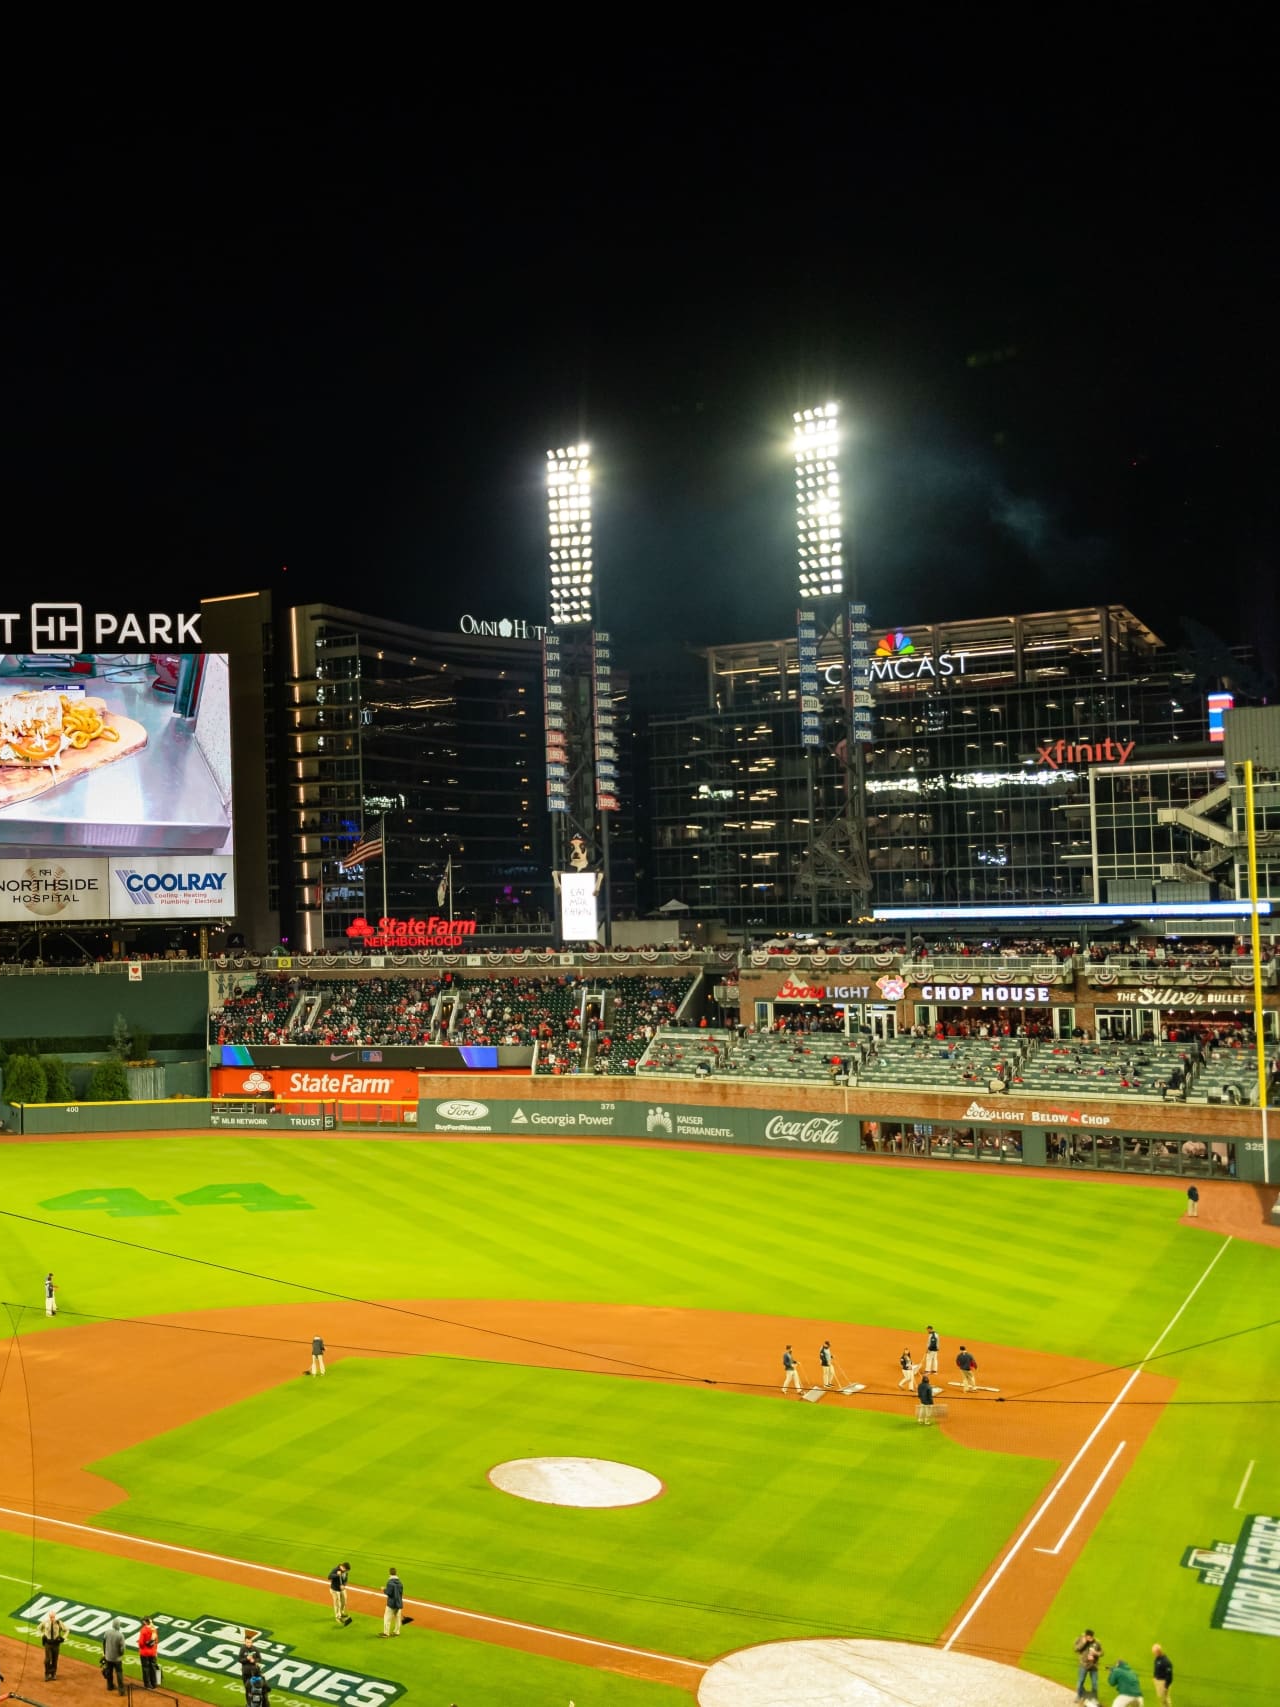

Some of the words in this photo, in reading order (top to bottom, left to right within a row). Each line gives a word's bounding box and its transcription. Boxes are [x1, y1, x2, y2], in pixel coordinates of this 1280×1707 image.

[95, 613, 202, 644] PARK
[460, 614, 498, 637] OMNI
[515, 619, 548, 641] HOT
[825, 654, 969, 684] CMCAST
[1037, 741, 1136, 769] xfinity
[126, 873, 227, 892] COOLRAY
[12, 894, 80, 903] HOSPITAL
[364, 936, 463, 947] NEIGHBORHOOD
[826, 986, 870, 999] LIGHT
[922, 986, 974, 1000] CHOP
[982, 987, 1049, 1001] HOUSE
[1117, 992, 1136, 1002] THE
[1138, 986, 1206, 1005] Silver
[1208, 993, 1246, 1004] BULLET
[447, 1104, 477, 1116] Ford
[997, 1112, 1024, 1120] LIGHT
[291, 1118, 320, 1126] TRUIST
[531, 1113, 575, 1126] Georgia
[579, 1114, 613, 1125] Power
[677, 1115, 703, 1125] KAISER
[1031, 1111, 1068, 1122] BELOW
[1081, 1114, 1110, 1125] CHOP
[677, 1126, 731, 1137] PERMANENTE
[765, 1115, 843, 1144] Coca-Cola
[1245, 1143, 1264, 1151] 325
[37, 1182, 316, 1218] 44
[153, 1615, 192, 1629] 20
[195, 1644, 398, 1707] SERIES
